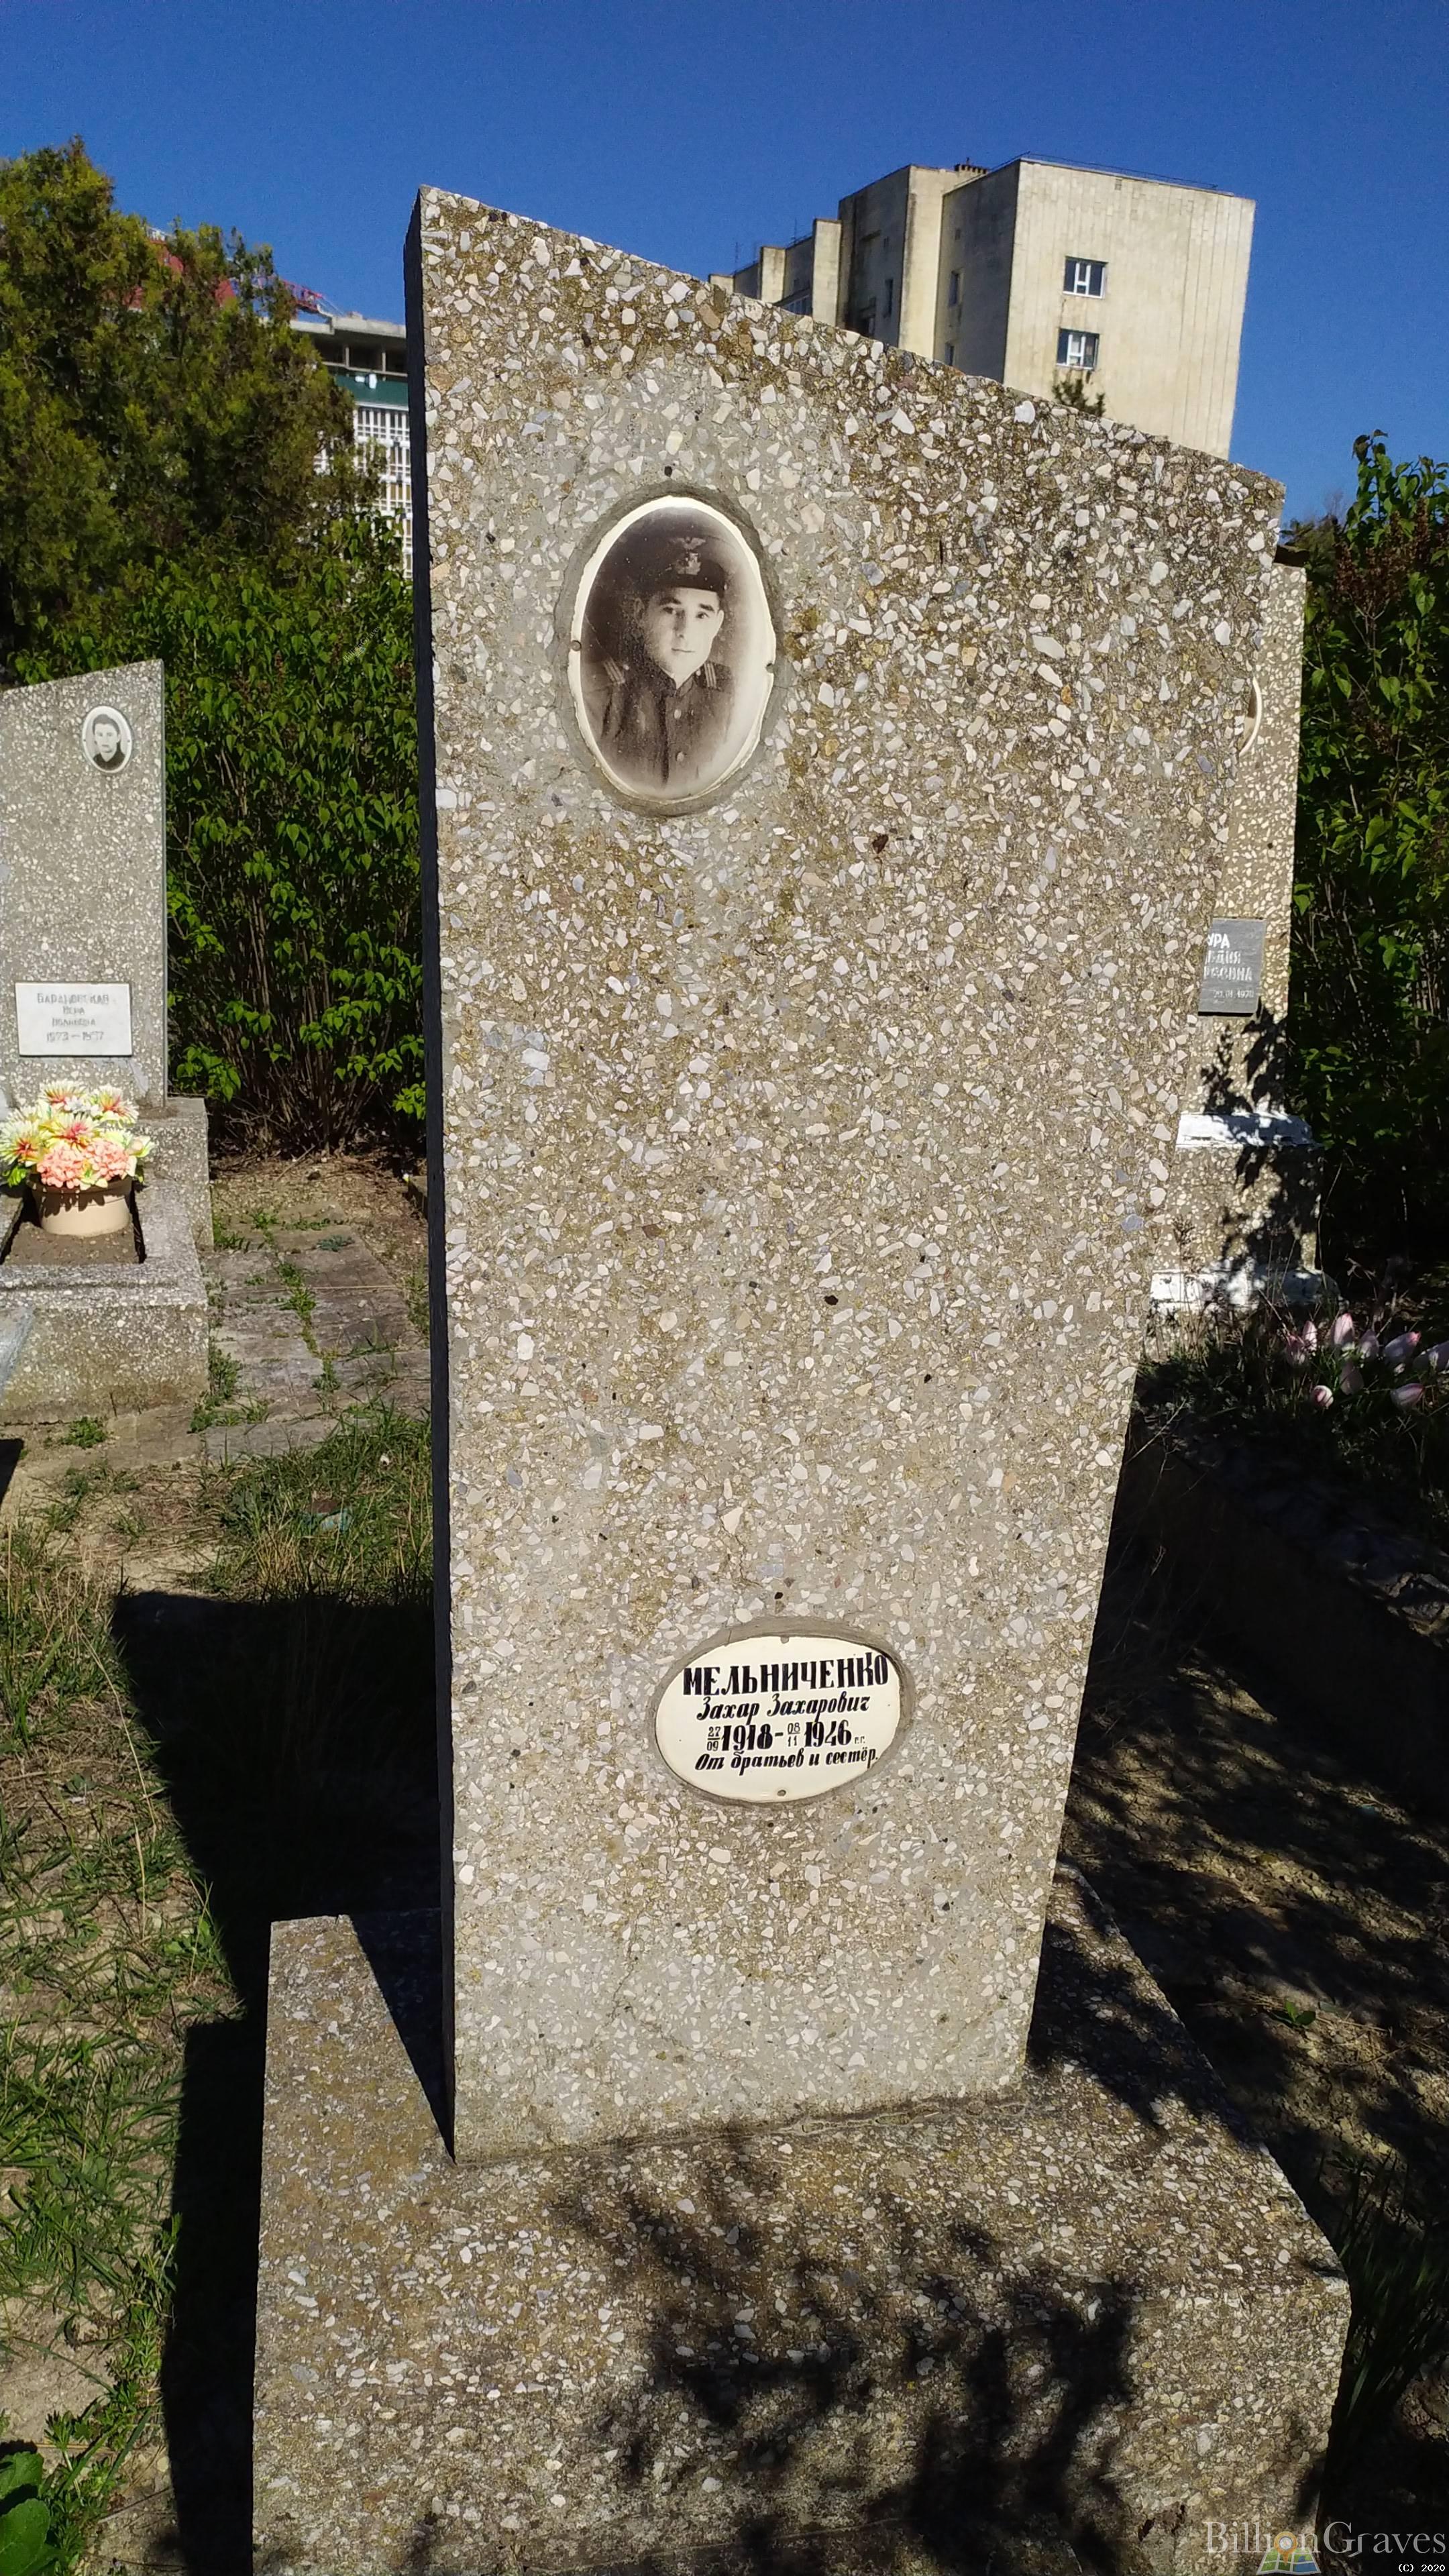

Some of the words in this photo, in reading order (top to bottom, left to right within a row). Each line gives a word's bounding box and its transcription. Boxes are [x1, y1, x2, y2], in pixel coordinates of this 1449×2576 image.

[683, 1652, 889, 1696] МЕЛЬНИЧЕНКО
[696, 1696, 760, 1725] Захар
[767, 1691, 871, 1723] Захарович
[694, 1753, 724, 1770] От
[731, 1748, 804, 1776] братьев
[808, 1754, 820, 1766] и
